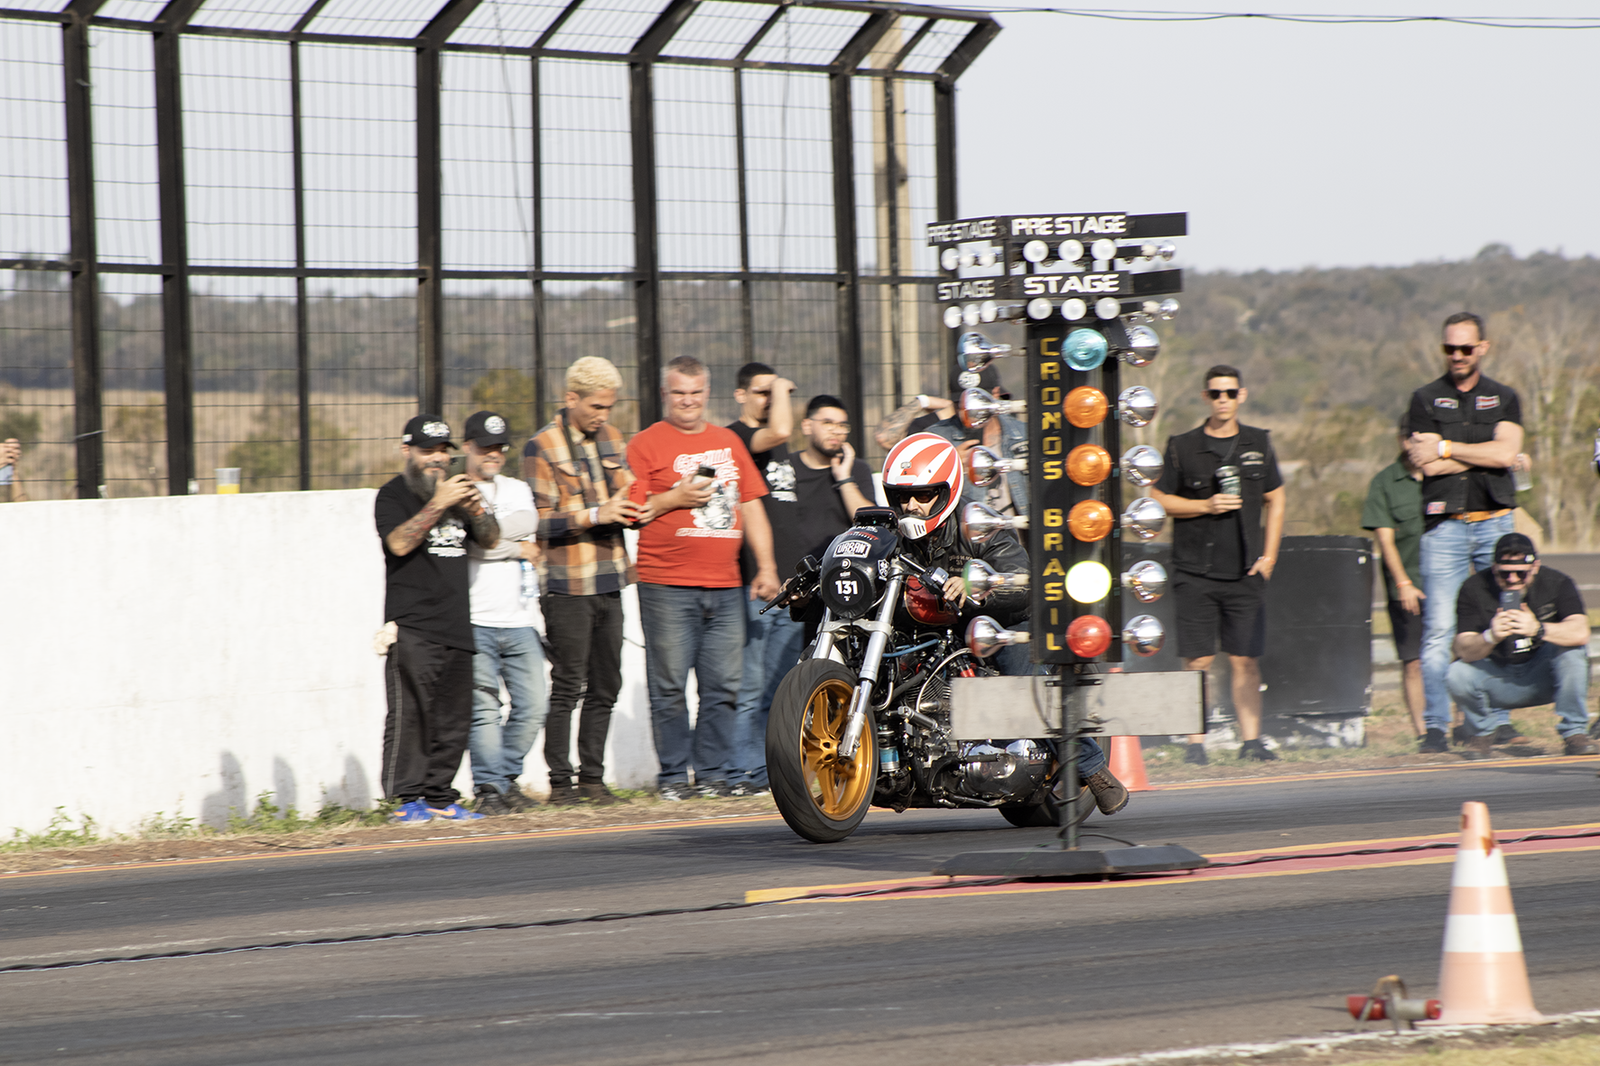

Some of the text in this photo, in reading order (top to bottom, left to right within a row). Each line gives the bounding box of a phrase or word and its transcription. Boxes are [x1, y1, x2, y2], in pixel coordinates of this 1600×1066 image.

[937, 279, 996, 301] STAGE
[1023, 273, 1120, 295] STAGE
[1040, 337, 1063, 481] CRONOS
[835, 580, 859, 595] 131
